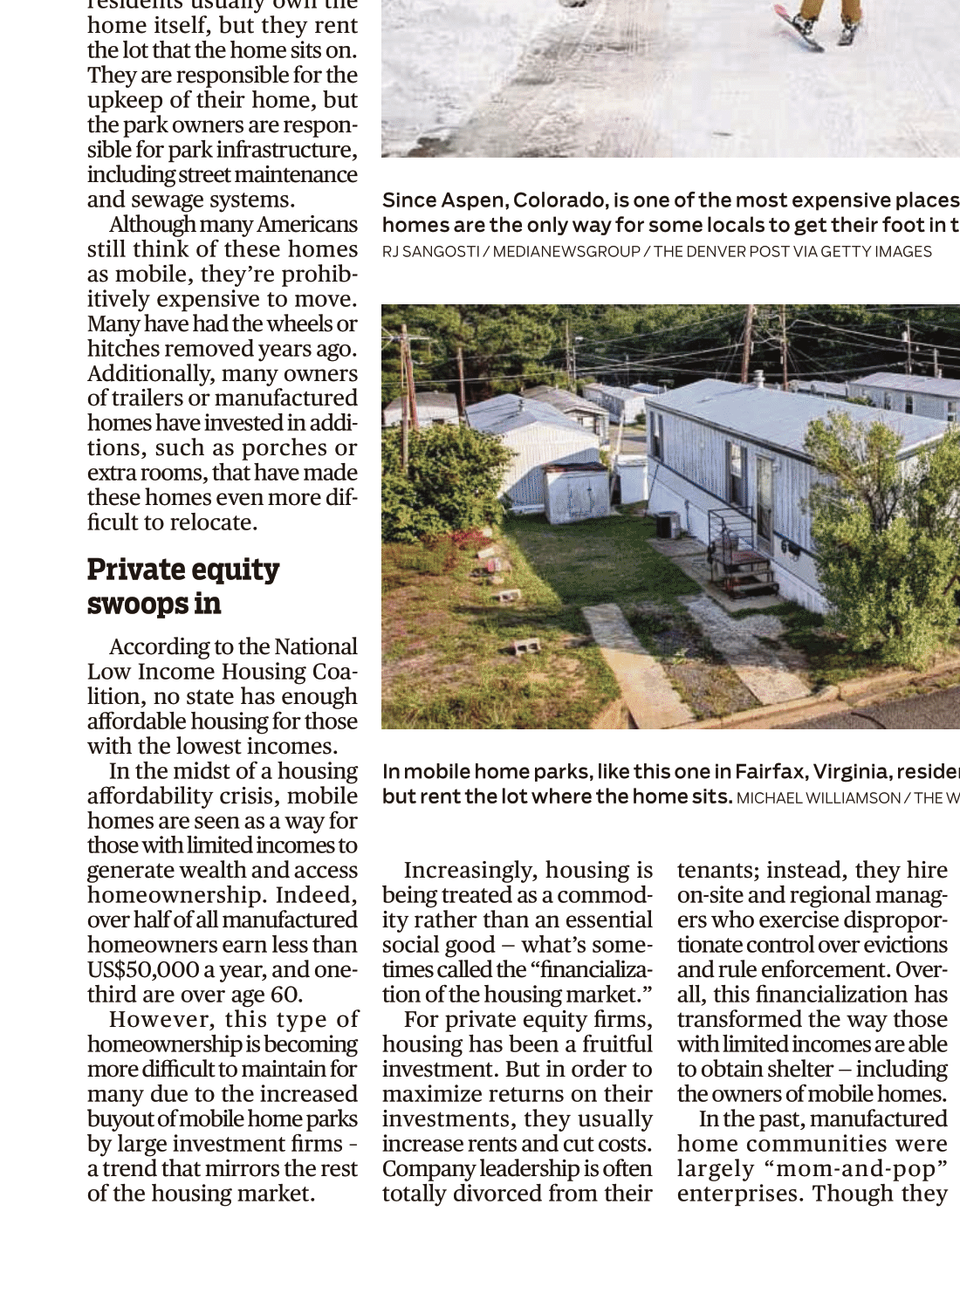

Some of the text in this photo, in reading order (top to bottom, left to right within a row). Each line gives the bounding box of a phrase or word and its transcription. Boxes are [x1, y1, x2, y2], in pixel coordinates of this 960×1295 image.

[383, 246, 932, 257] RJ SANGOSTI MEDIANEWSGROUP THE DENVER POST VIA GETTY IMAGES
[88, 557, 280, 585] Private equity
[88, 591, 221, 619] swoops in
[383, 788, 416, 804] but
[421, 789, 461, 804] rent
[465, 788, 497, 804] the
[502, 788, 528, 804] lot
[532, 788, 592, 804] where
[596, 788, 628, 804] the
[634, 788, 688, 804] home
[692, 789, 732, 804] sits.
[738, 792, 803, 804] MICHAEL
[806, 792, 900, 804] WILLIAMSON
[914, 792, 942, 804] THE
[88, 960, 358, 982] US$50,000 a year, and one-
